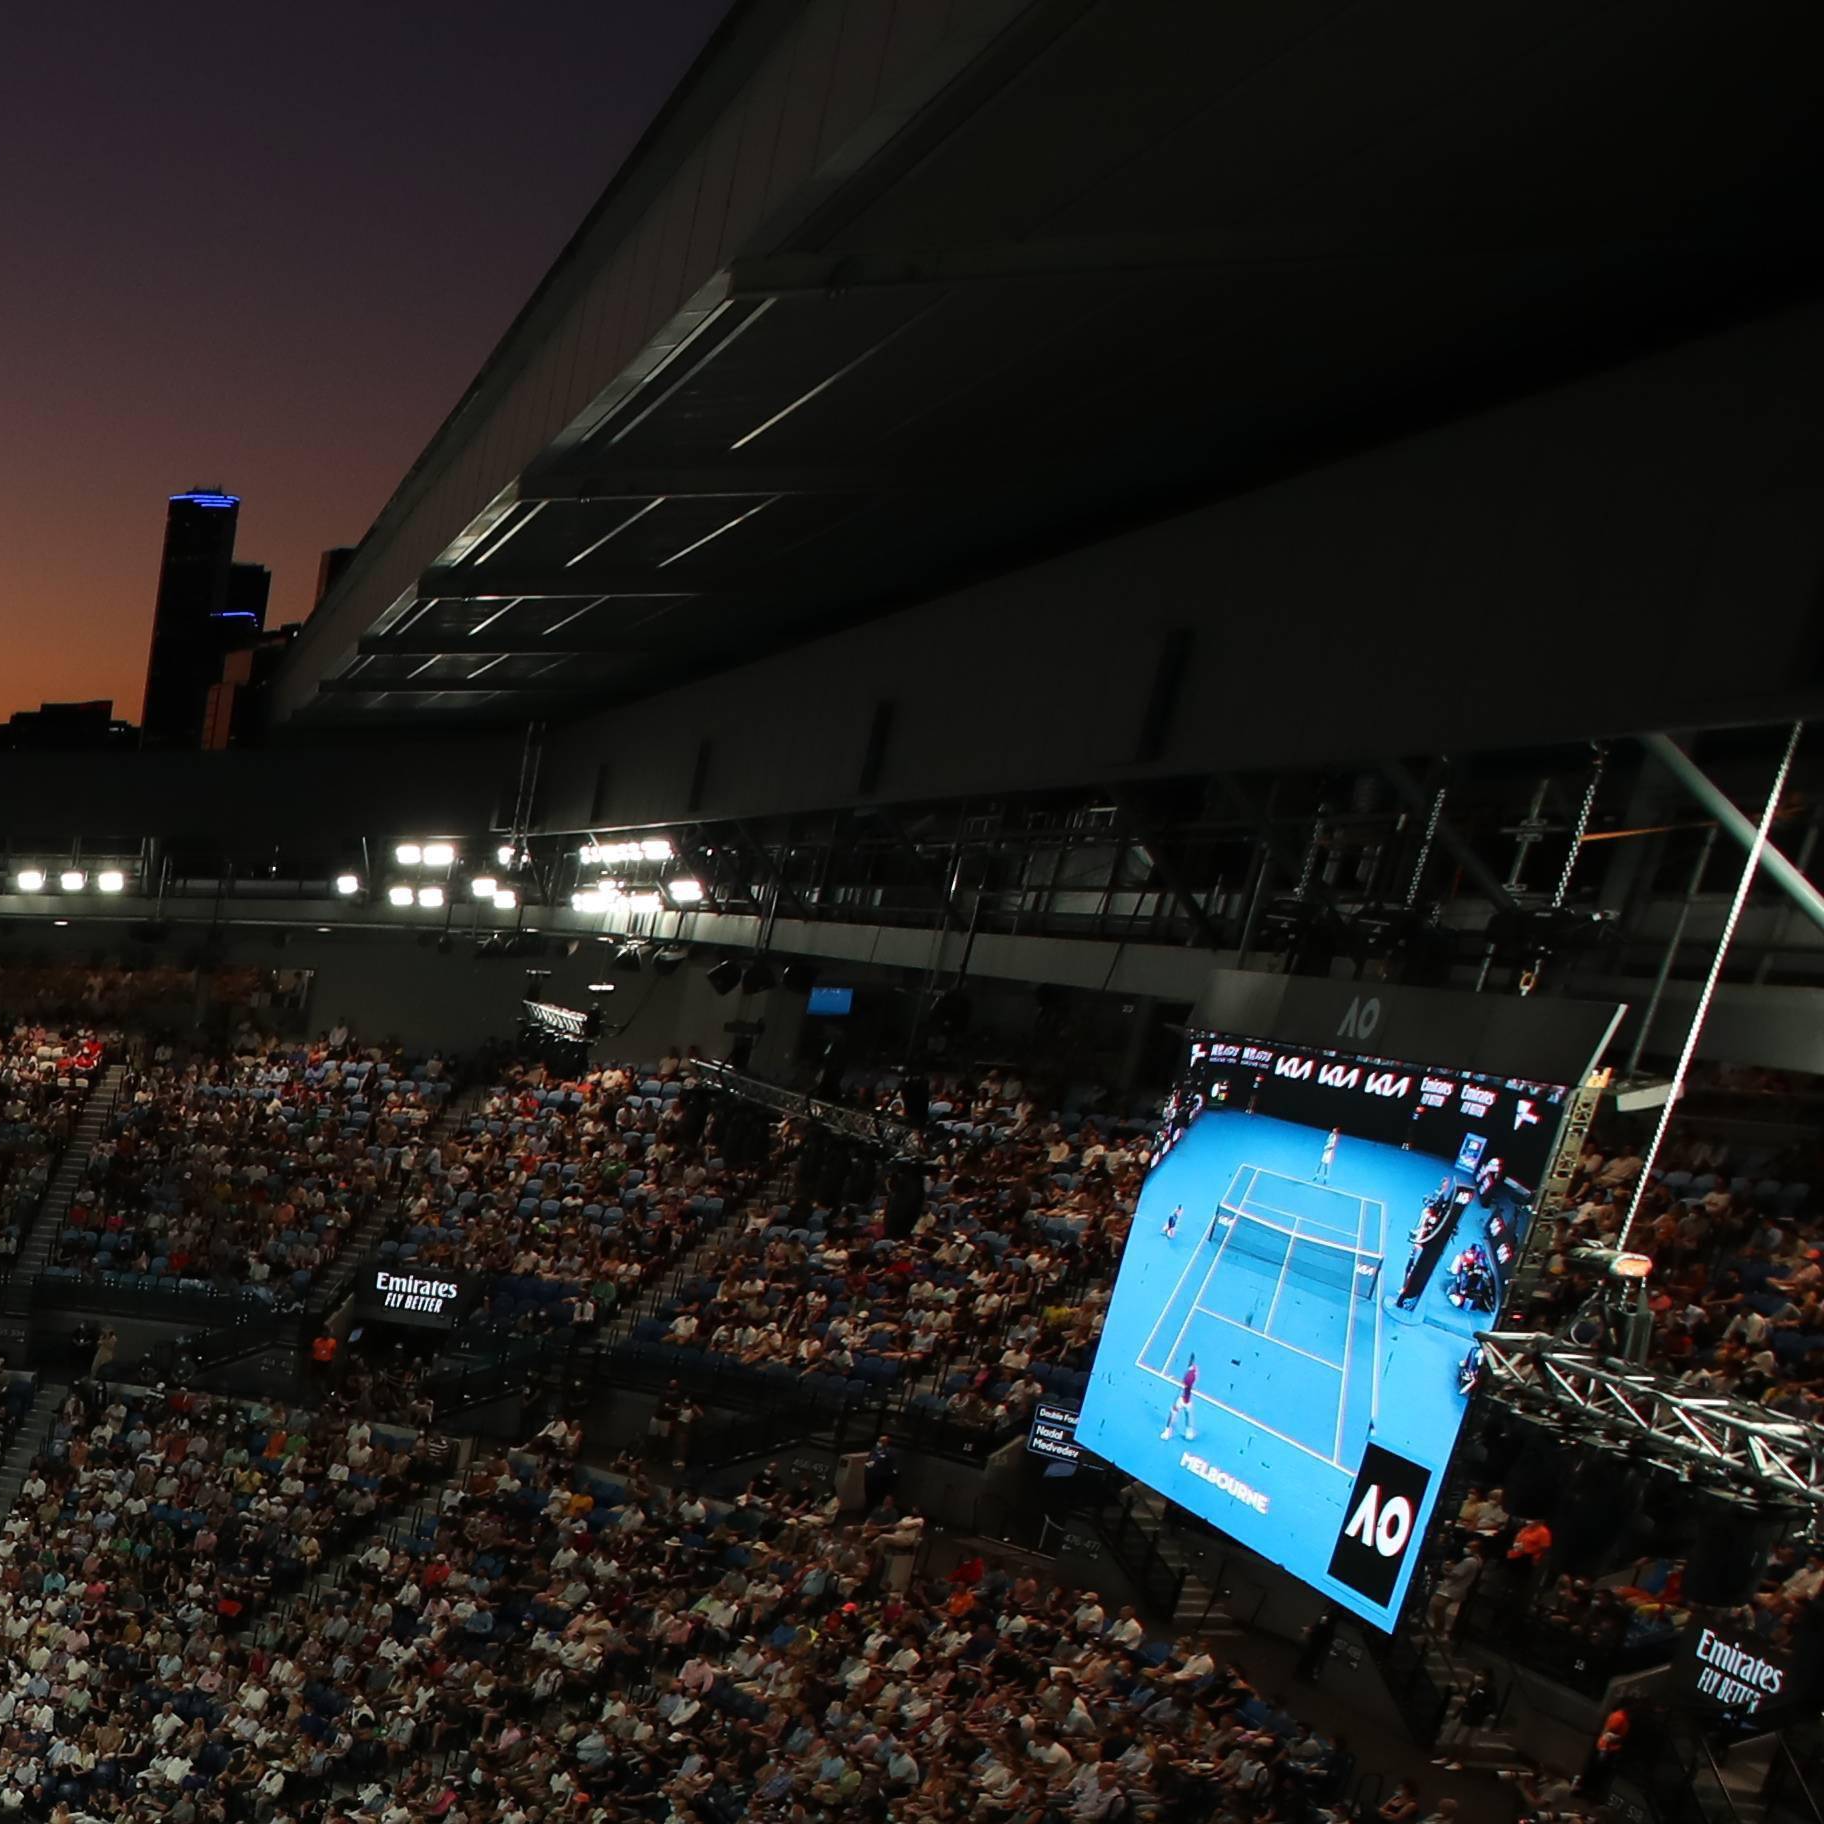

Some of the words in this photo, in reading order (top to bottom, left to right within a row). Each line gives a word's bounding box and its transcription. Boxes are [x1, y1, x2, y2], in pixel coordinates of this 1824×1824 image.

[376, 1271, 458, 1299] Emirates
[384, 1292, 403, 1308] FLY
[404, 1293, 443, 1314] BETTER
[1036, 1425, 1064, 1440] Nadal
[1032, 1438, 1080, 1458] Medvedev
[1180, 1451, 1270, 1514] MELBOURNE
[1696, 1628, 1784, 1694] Emirates
[1697, 1667, 1721, 1695] FLY
